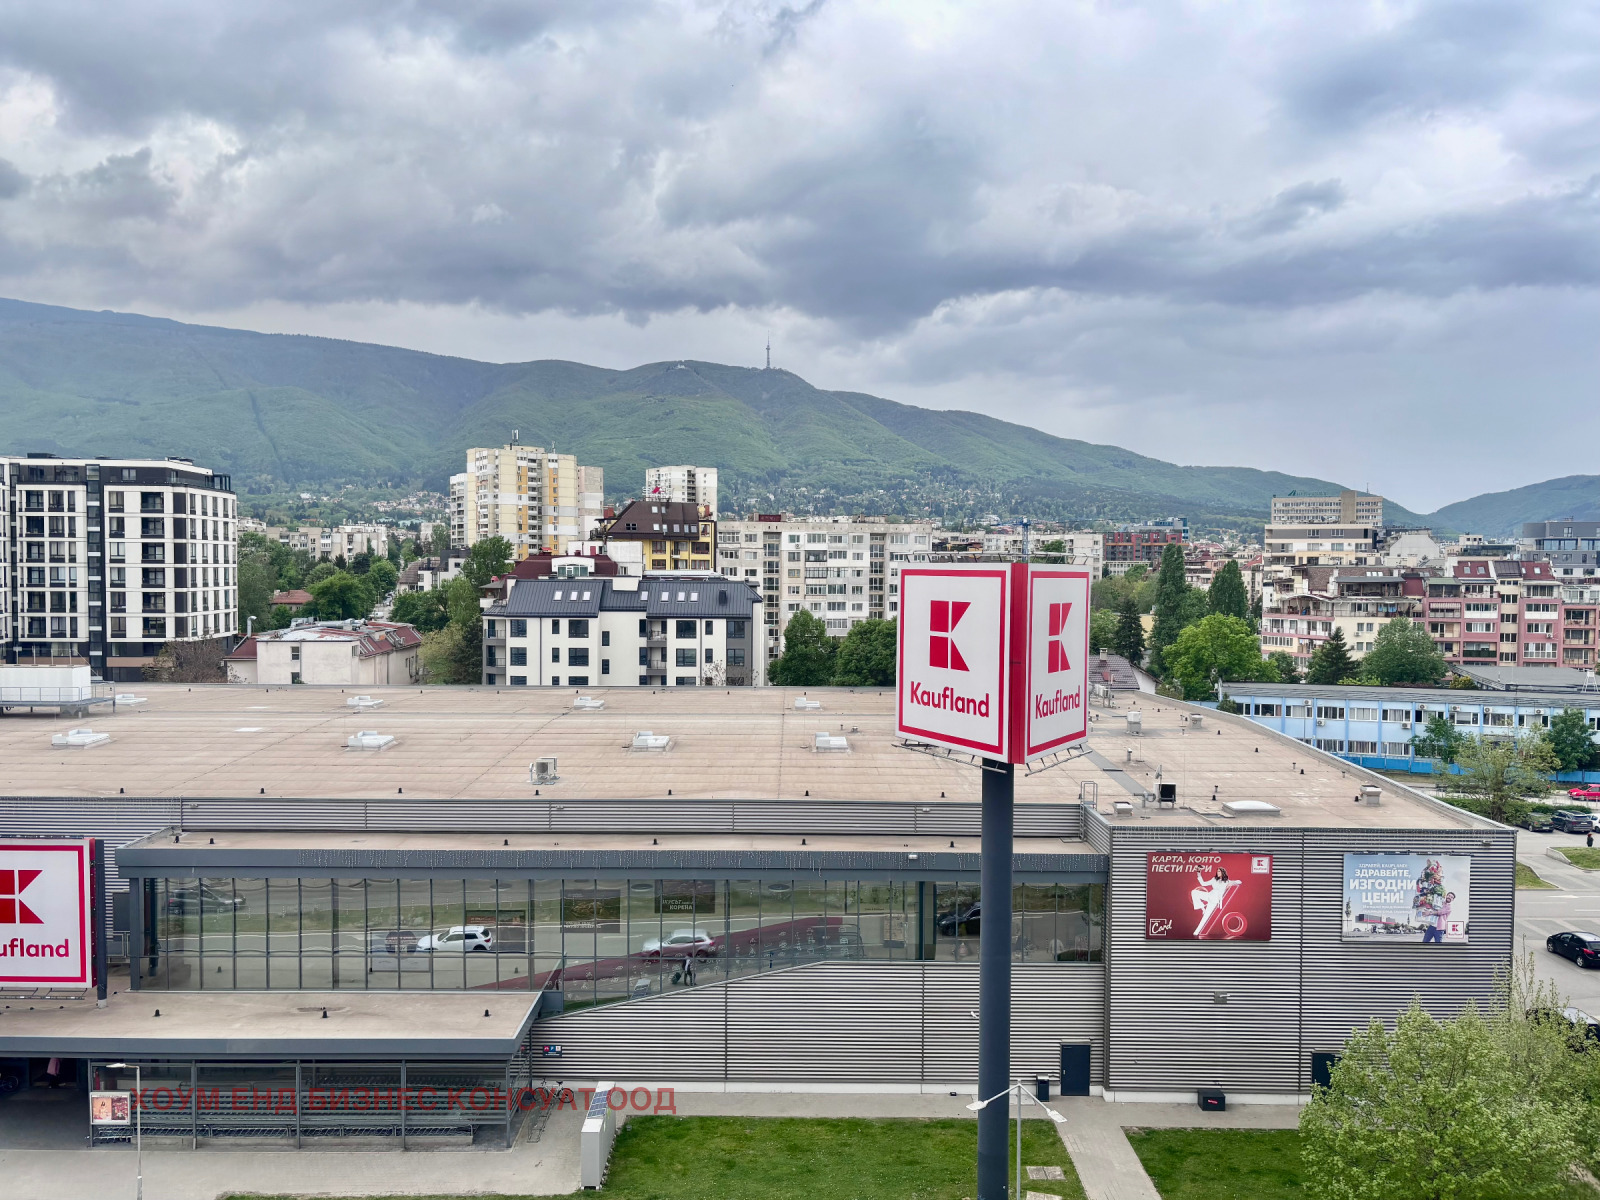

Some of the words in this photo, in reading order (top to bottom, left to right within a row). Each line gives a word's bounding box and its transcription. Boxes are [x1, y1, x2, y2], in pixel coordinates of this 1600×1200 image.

[910, 681, 990, 718] Kaufland
[1035, 685, 1081, 719] Kaufland
[1151, 855, 1186, 864] КАРТА,
[1188, 855, 1222, 863] КОЯТО
[1151, 864, 1183, 872] ПЕСТИ
[1355, 868, 1411, 878] ЗДРАВЕЙТЕ,
[1349, 879, 1417, 892] ИЗГОДНИ
[1361, 891, 1404, 905] ЦЕНИ!
